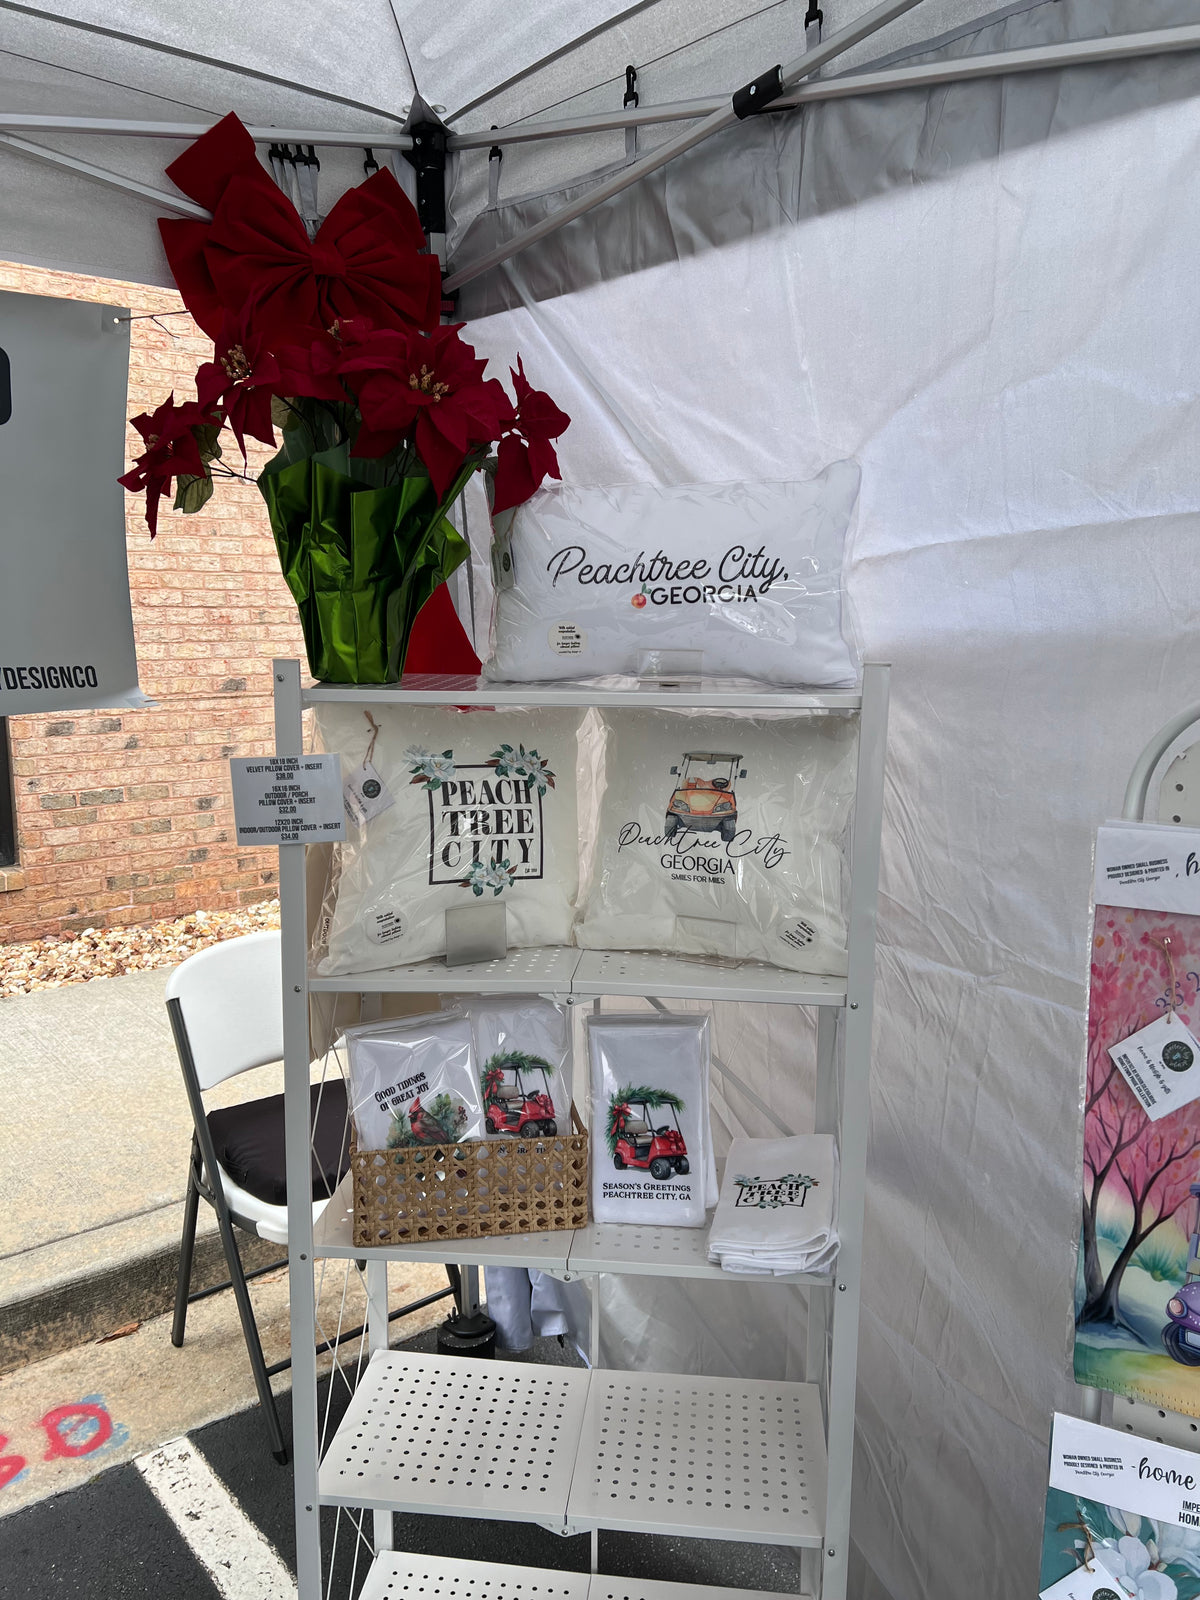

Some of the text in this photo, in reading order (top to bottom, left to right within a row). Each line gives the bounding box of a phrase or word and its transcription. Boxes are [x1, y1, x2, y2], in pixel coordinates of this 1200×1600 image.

[547, 545, 711, 588] Peachtree
[718, 545, 789, 594] City,
[650, 584, 758, 605] GEORGIA
[0, 665, 98, 690] DESIGNCO
[441, 779, 533, 806] PEACH
[279, 806, 297, 814] $32.00
[323, 822, 341, 830] INSERT
[442, 809, 534, 836] TREE
[281, 833, 299, 841] $34.00
[618, 821, 791, 869] Peachtree City
[442, 839, 534, 868] CITY
[660, 854, 736, 875] GEORGIA
[693, 875, 707, 883] FOR
[375, 1072, 426, 1103] GOOD TIDINGS
[391, 1090, 415, 1106] GREAT
[416, 1082, 429, 1095] JOY
[603, 1191, 654, 1200] PEACHTREE
[655, 1192, 678, 1201] CITY,
[748, 1183, 800, 1191] PEACH
[1139, 1457, 1197, 1490] home
